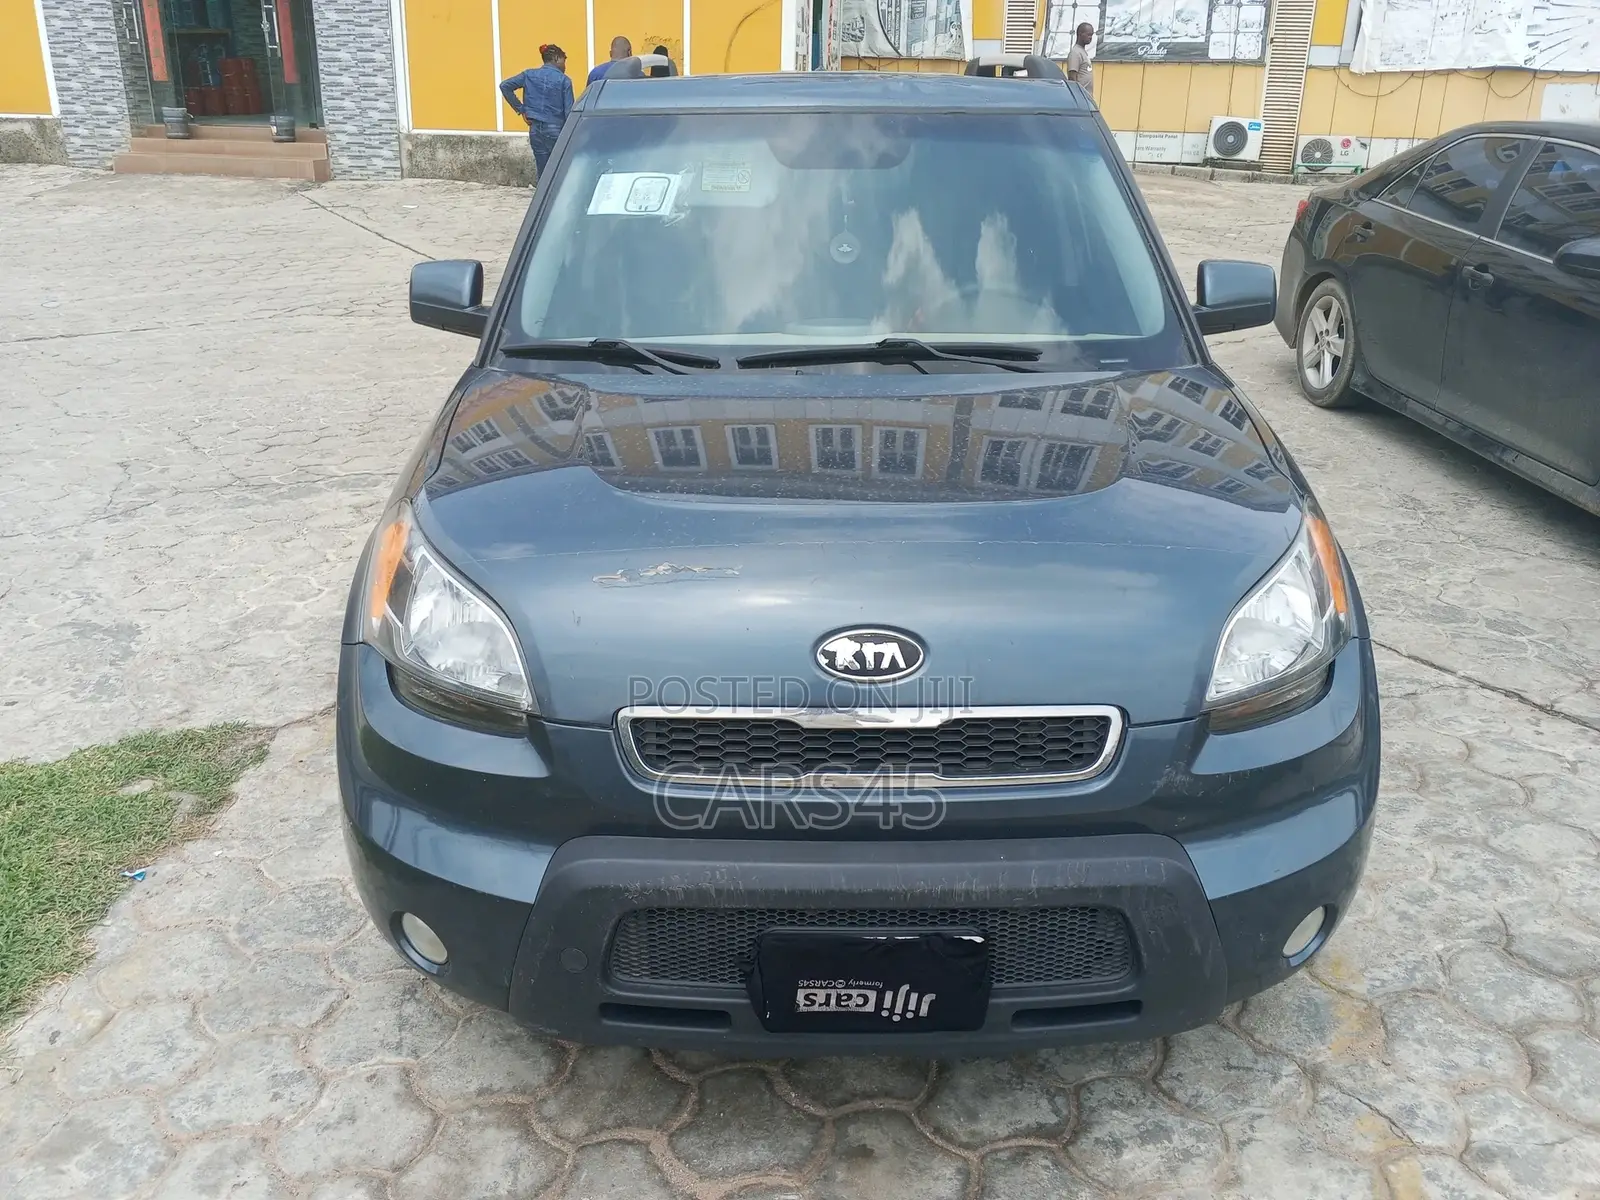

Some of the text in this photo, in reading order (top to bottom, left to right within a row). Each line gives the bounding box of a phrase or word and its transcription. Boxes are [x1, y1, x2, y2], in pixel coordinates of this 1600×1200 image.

[1138, 45, 1167, 55] Panda
[820, 636, 907, 670] KIA
[798, 978, 884, 988] formerly CARS45
[803, 983, 937, 1022] Jiji cars
